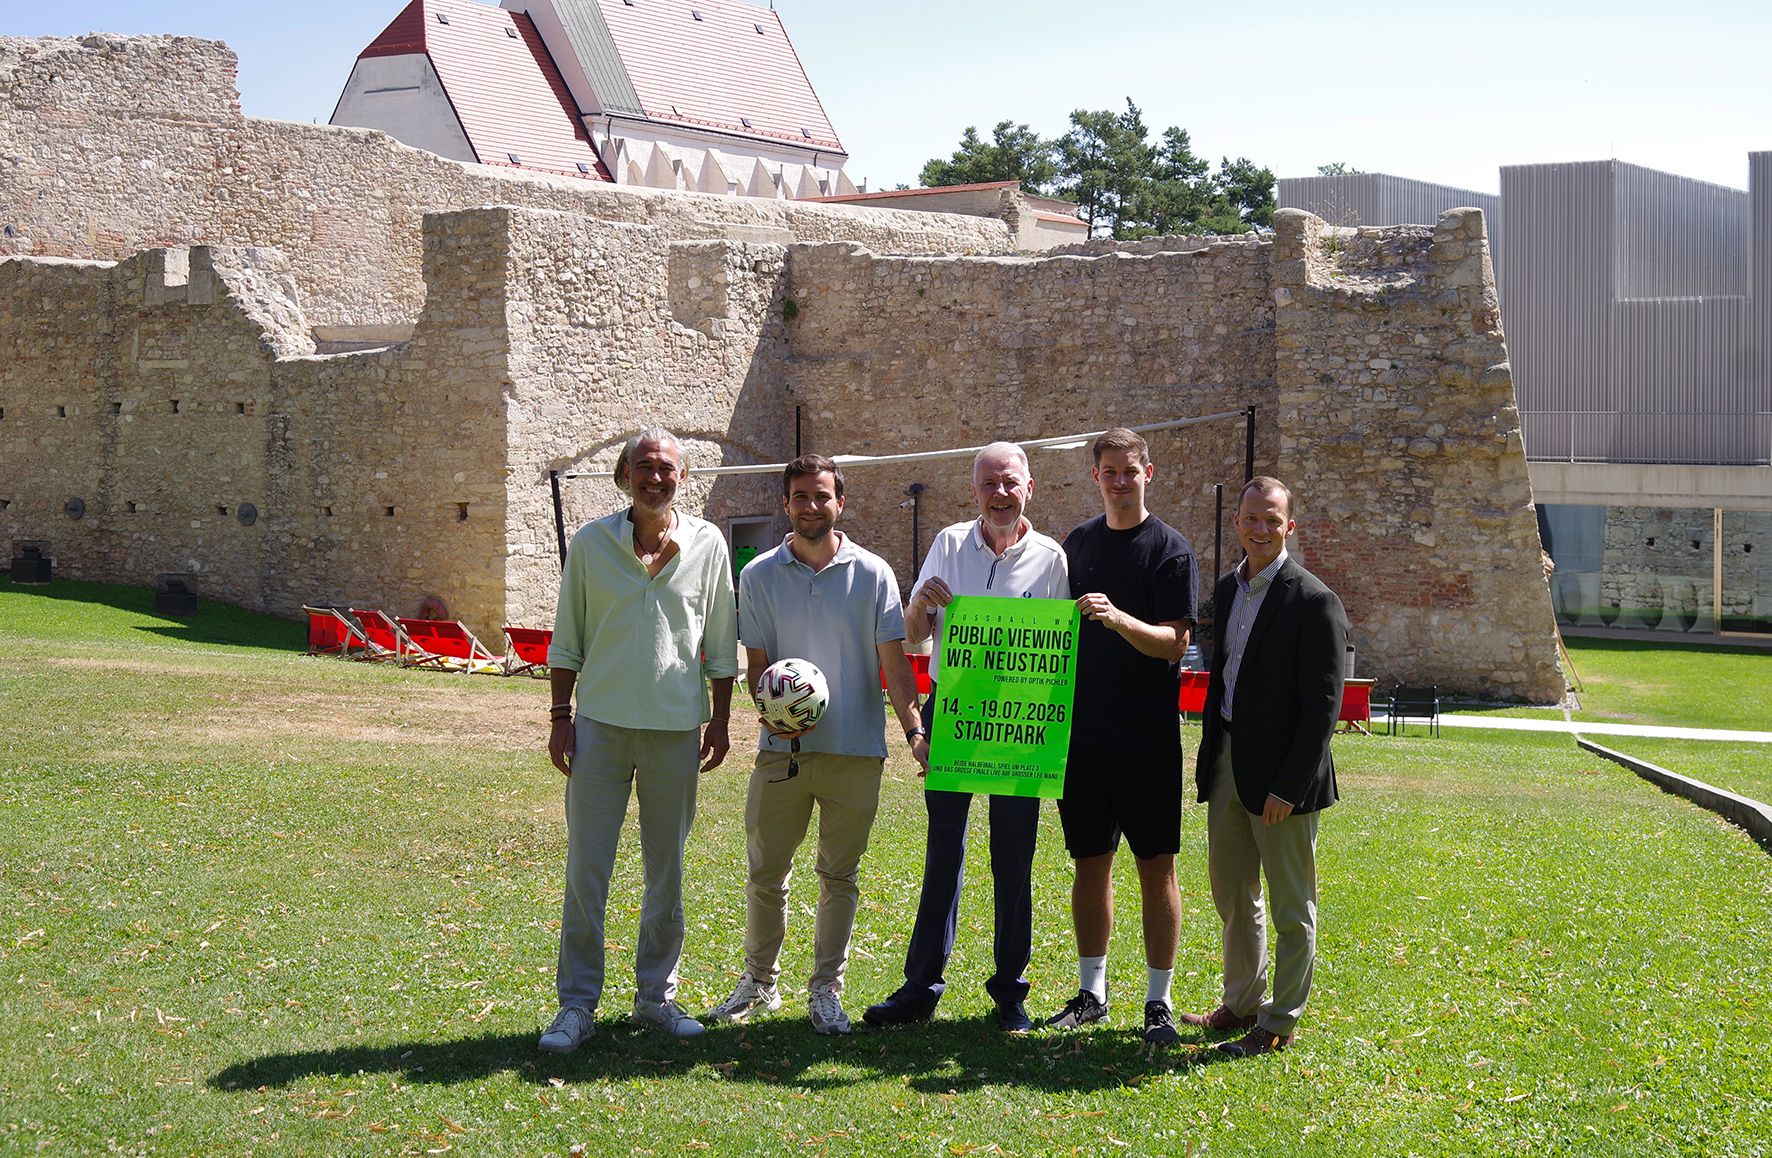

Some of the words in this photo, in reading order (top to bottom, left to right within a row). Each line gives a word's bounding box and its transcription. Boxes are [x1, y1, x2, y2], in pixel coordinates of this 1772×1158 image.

[951, 613, 1036, 625] FUSSBALL
[949, 625, 1003, 647] PUBLIC
[1008, 628, 1072, 650] VIEWING
[947, 648, 976, 669] WR.
[984, 650, 1070, 674] NEUSTADT
[993, 675, 1019, 684] POWERED
[1020, 676, 1028, 684] BY
[1029, 677, 1045, 685] OPTIK
[1046, 678, 1068, 686] PICHLER
[942, 697, 962, 716] 14.
[980, 699, 1066, 723] 19.07.2026
[954, 720, 1047, 745] STADTPARK
[954, 766, 972, 774] GROSSE
[1011, 770, 1033, 778] GROSSER
